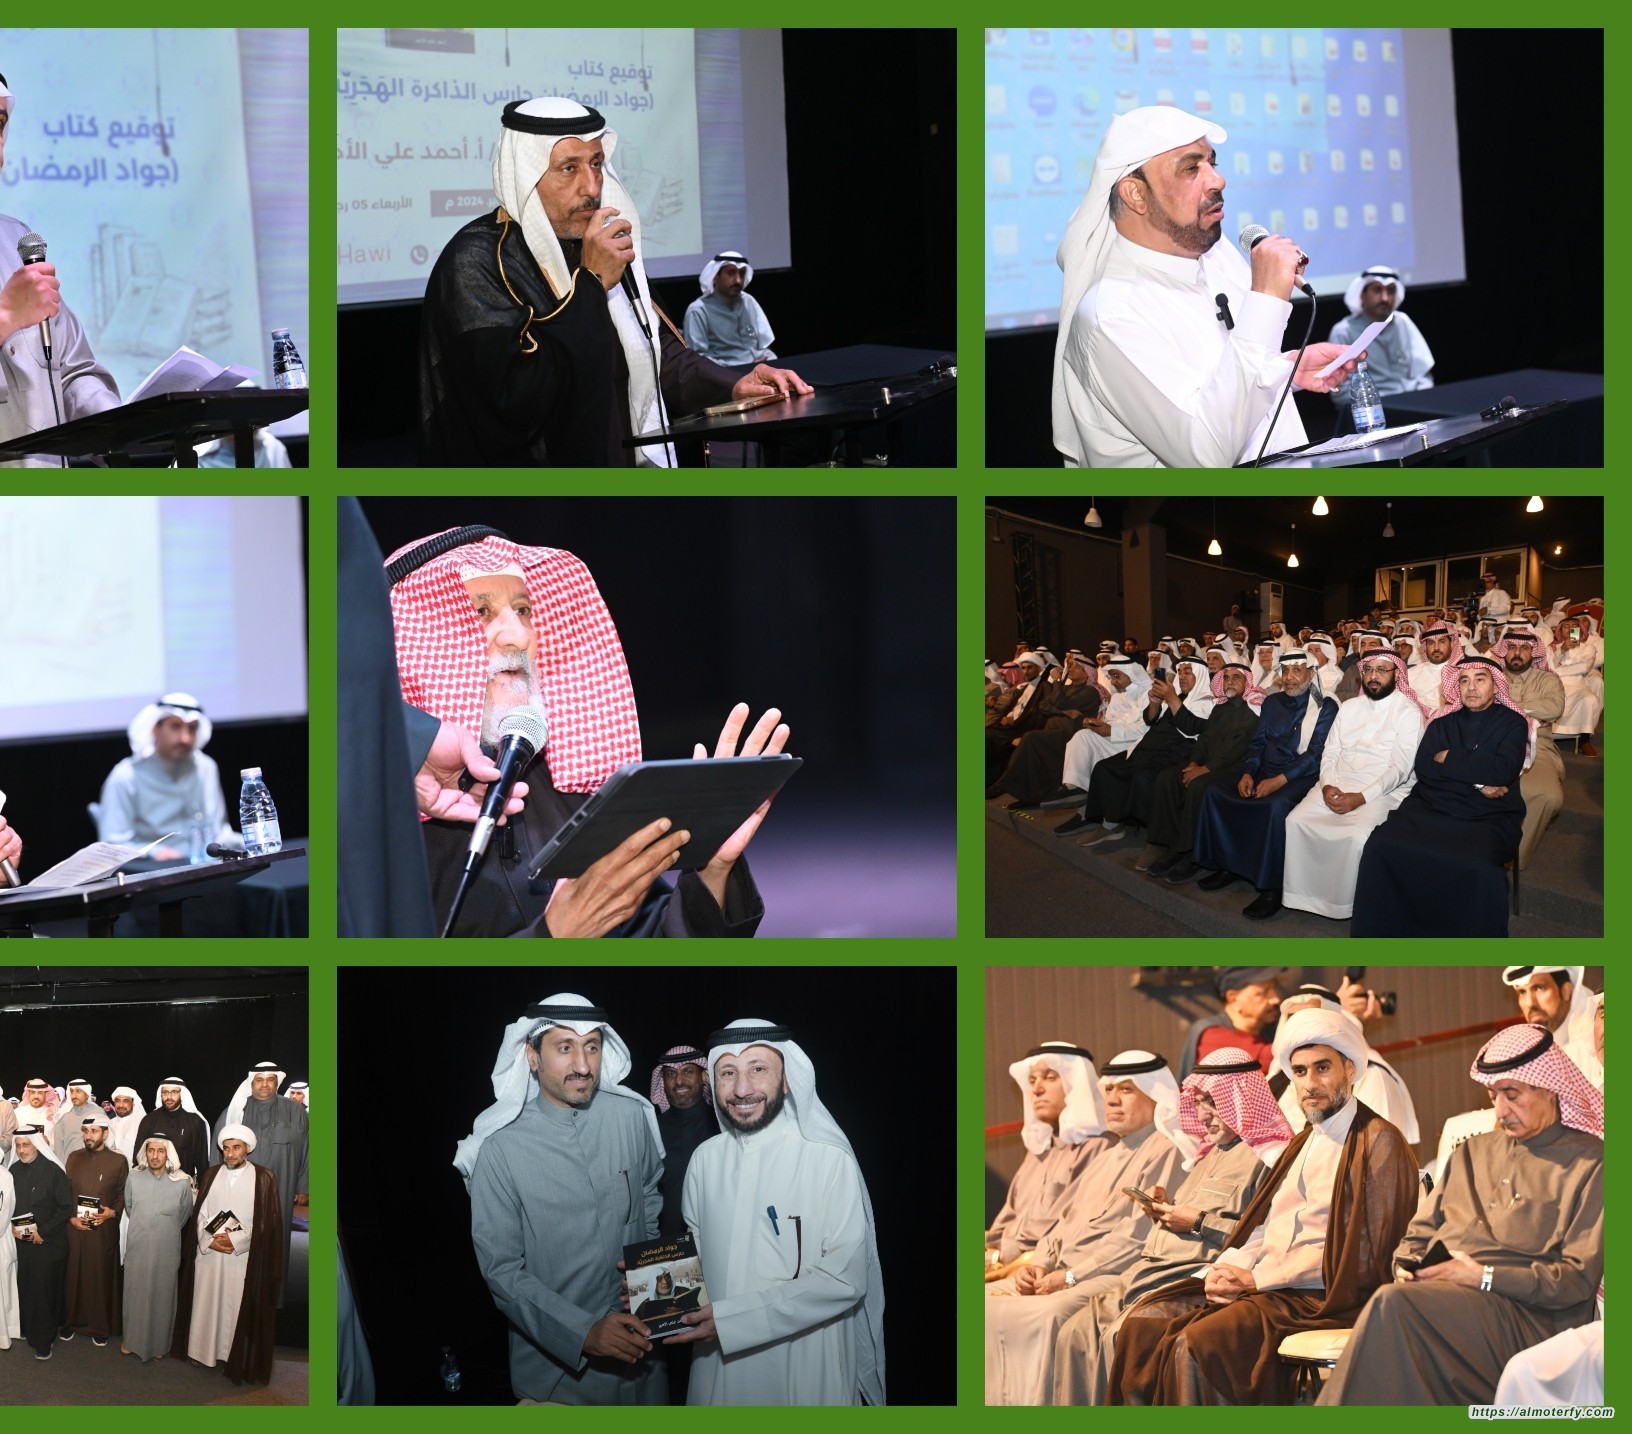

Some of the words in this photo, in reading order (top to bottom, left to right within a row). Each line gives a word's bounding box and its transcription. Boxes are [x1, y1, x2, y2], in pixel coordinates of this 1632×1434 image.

[568, 60, 604, 80] كتاب
[609, 64, 653, 85] توقيع
[411, 79, 476, 103] الذاكرة
[43, 113, 99, 145] كتاب
[107, 116, 176, 149] توقيع
[375, 142, 414, 169] علي
[420, 136, 468, 160] أحمد
[2, 155, 107, 188] الرمضان
[352, 199, 368, 210] 05
[371, 196, 412, 211] الأربعاء
[457, 196, 484, 207] 2024
[338, 243, 392, 264] Hawi
